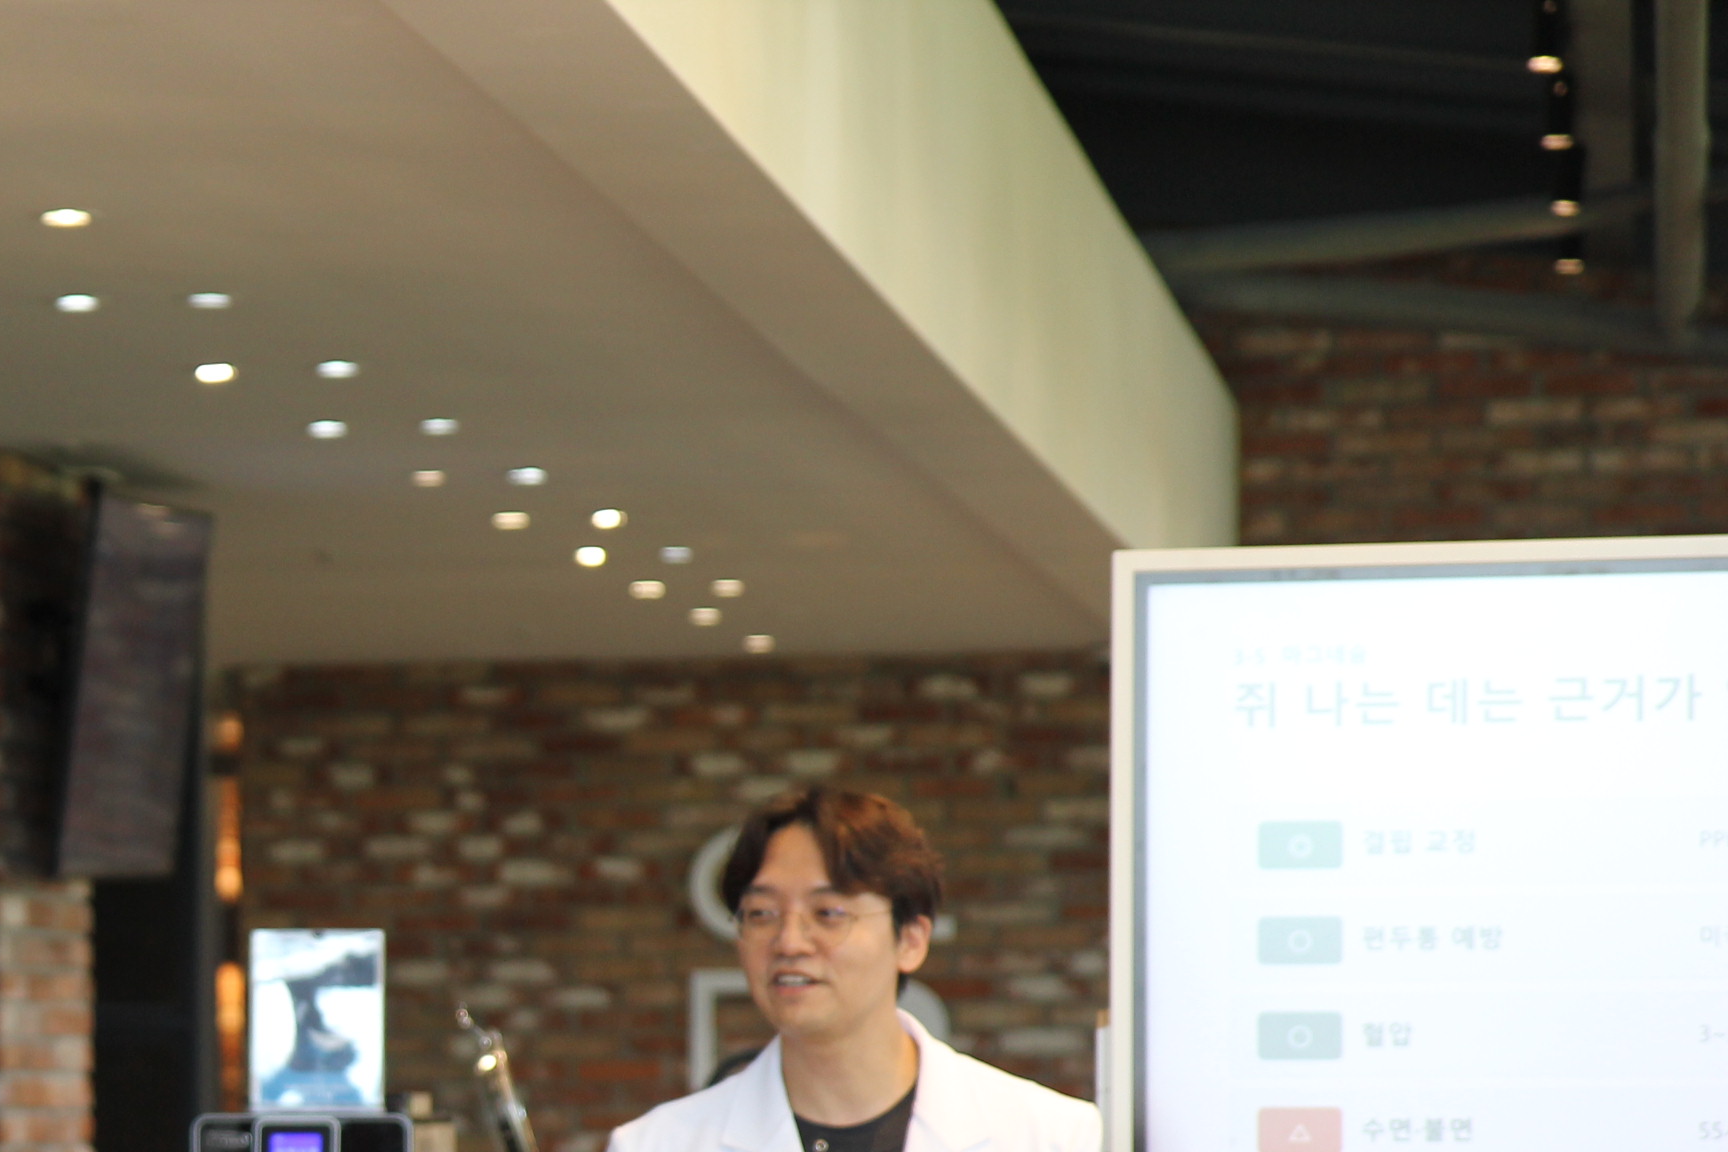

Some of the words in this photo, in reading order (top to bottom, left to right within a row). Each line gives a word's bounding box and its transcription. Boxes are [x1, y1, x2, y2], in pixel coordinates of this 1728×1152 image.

[1234, 682, 1276, 728] 쥐
[1305, 680, 1401, 727] 나는
[1426, 678, 1523, 725] 데는
[1548, 672, 1703, 722] 근거가
[1425, 830, 1475, 855] 교정
[1363, 926, 1438, 952] 편두통
[1452, 926, 1503, 951] 예방
[1362, 1022, 1412, 1048] 혈압
